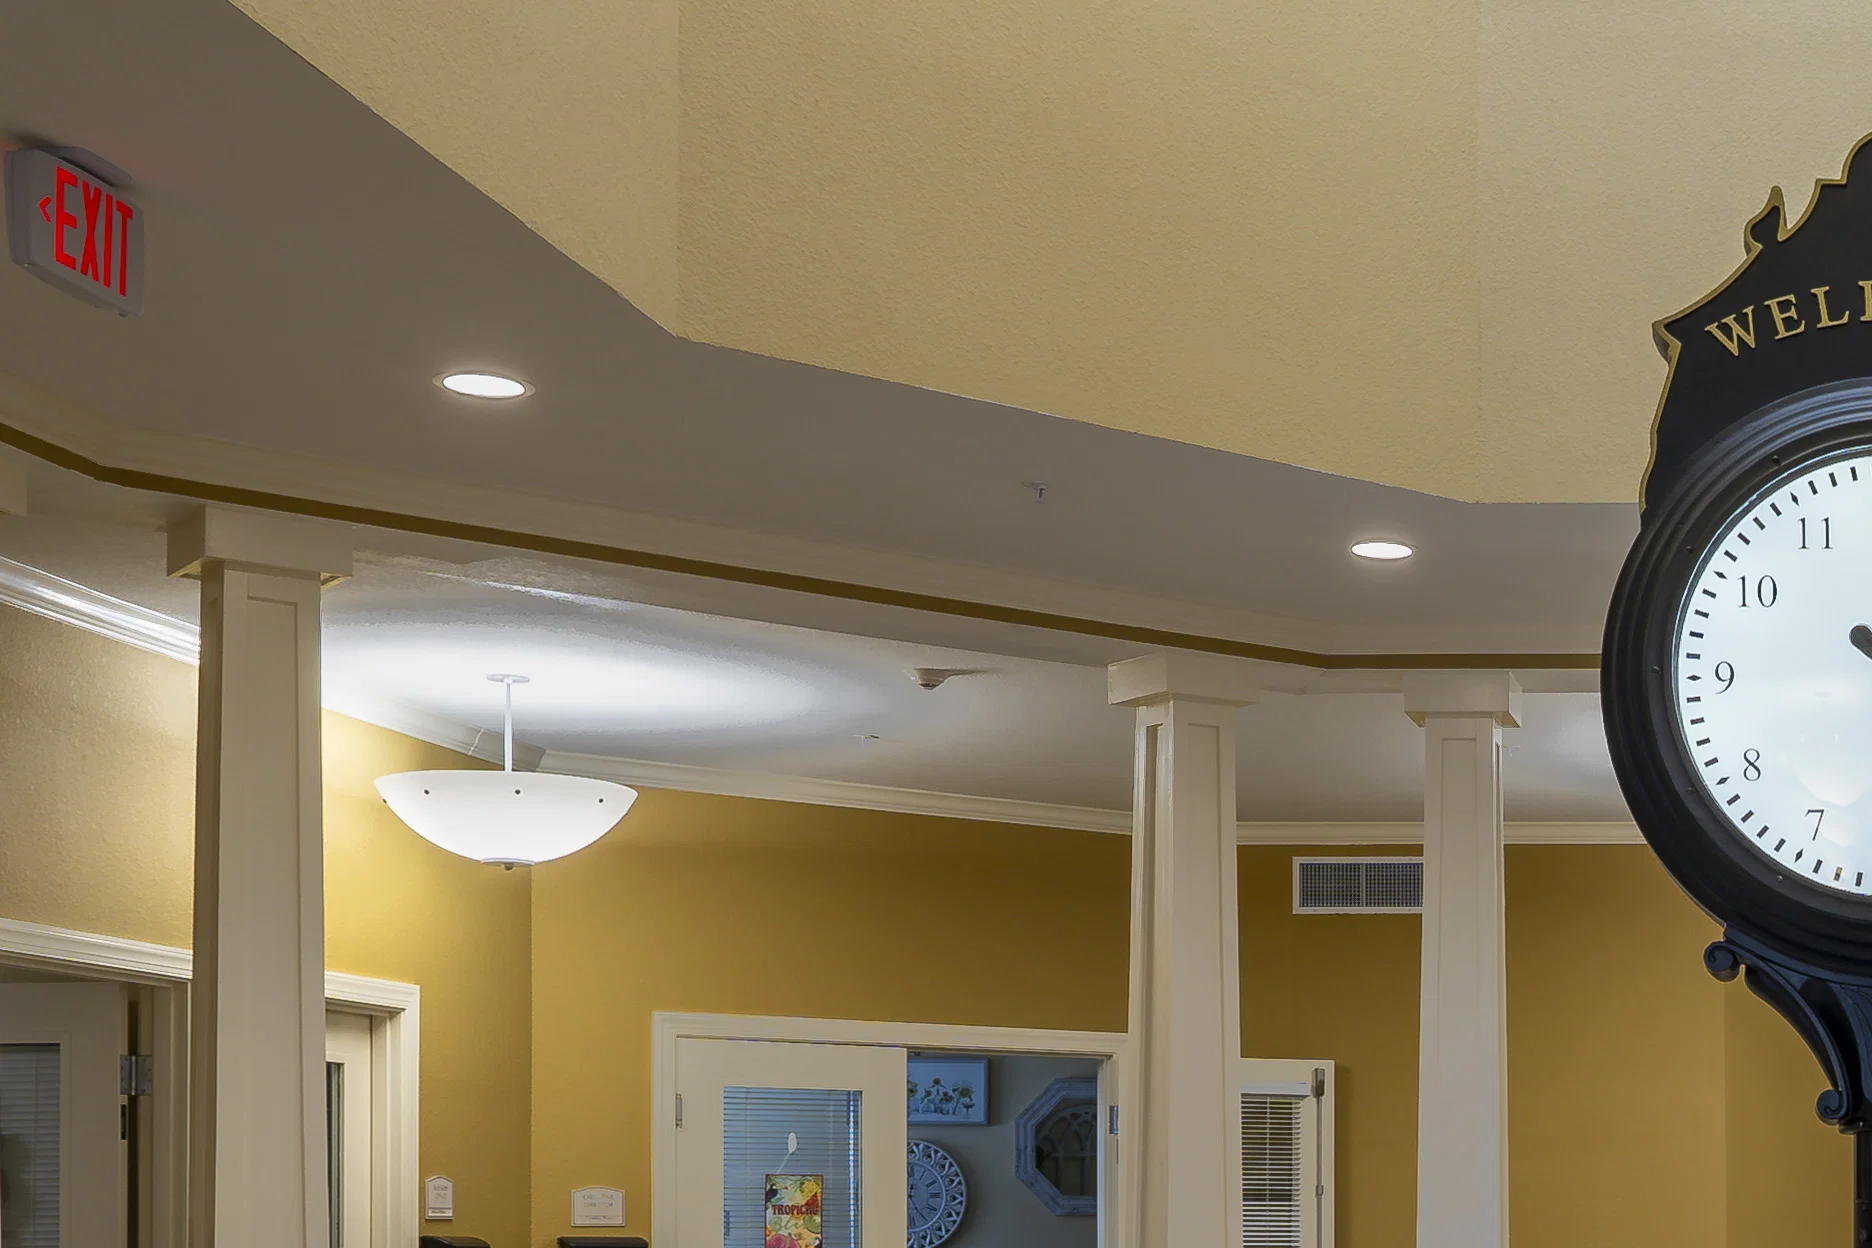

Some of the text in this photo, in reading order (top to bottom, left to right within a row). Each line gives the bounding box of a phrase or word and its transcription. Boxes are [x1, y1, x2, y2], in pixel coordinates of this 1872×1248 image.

[55, 166, 133, 297] EXIT
[1797, 516, 1834, 550] 11
[1737, 574, 1778, 608] 10
[1715, 662, 1734, 693] 9
[1744, 749, 1761, 781] 8
[1806, 809, 1824, 841] 7
